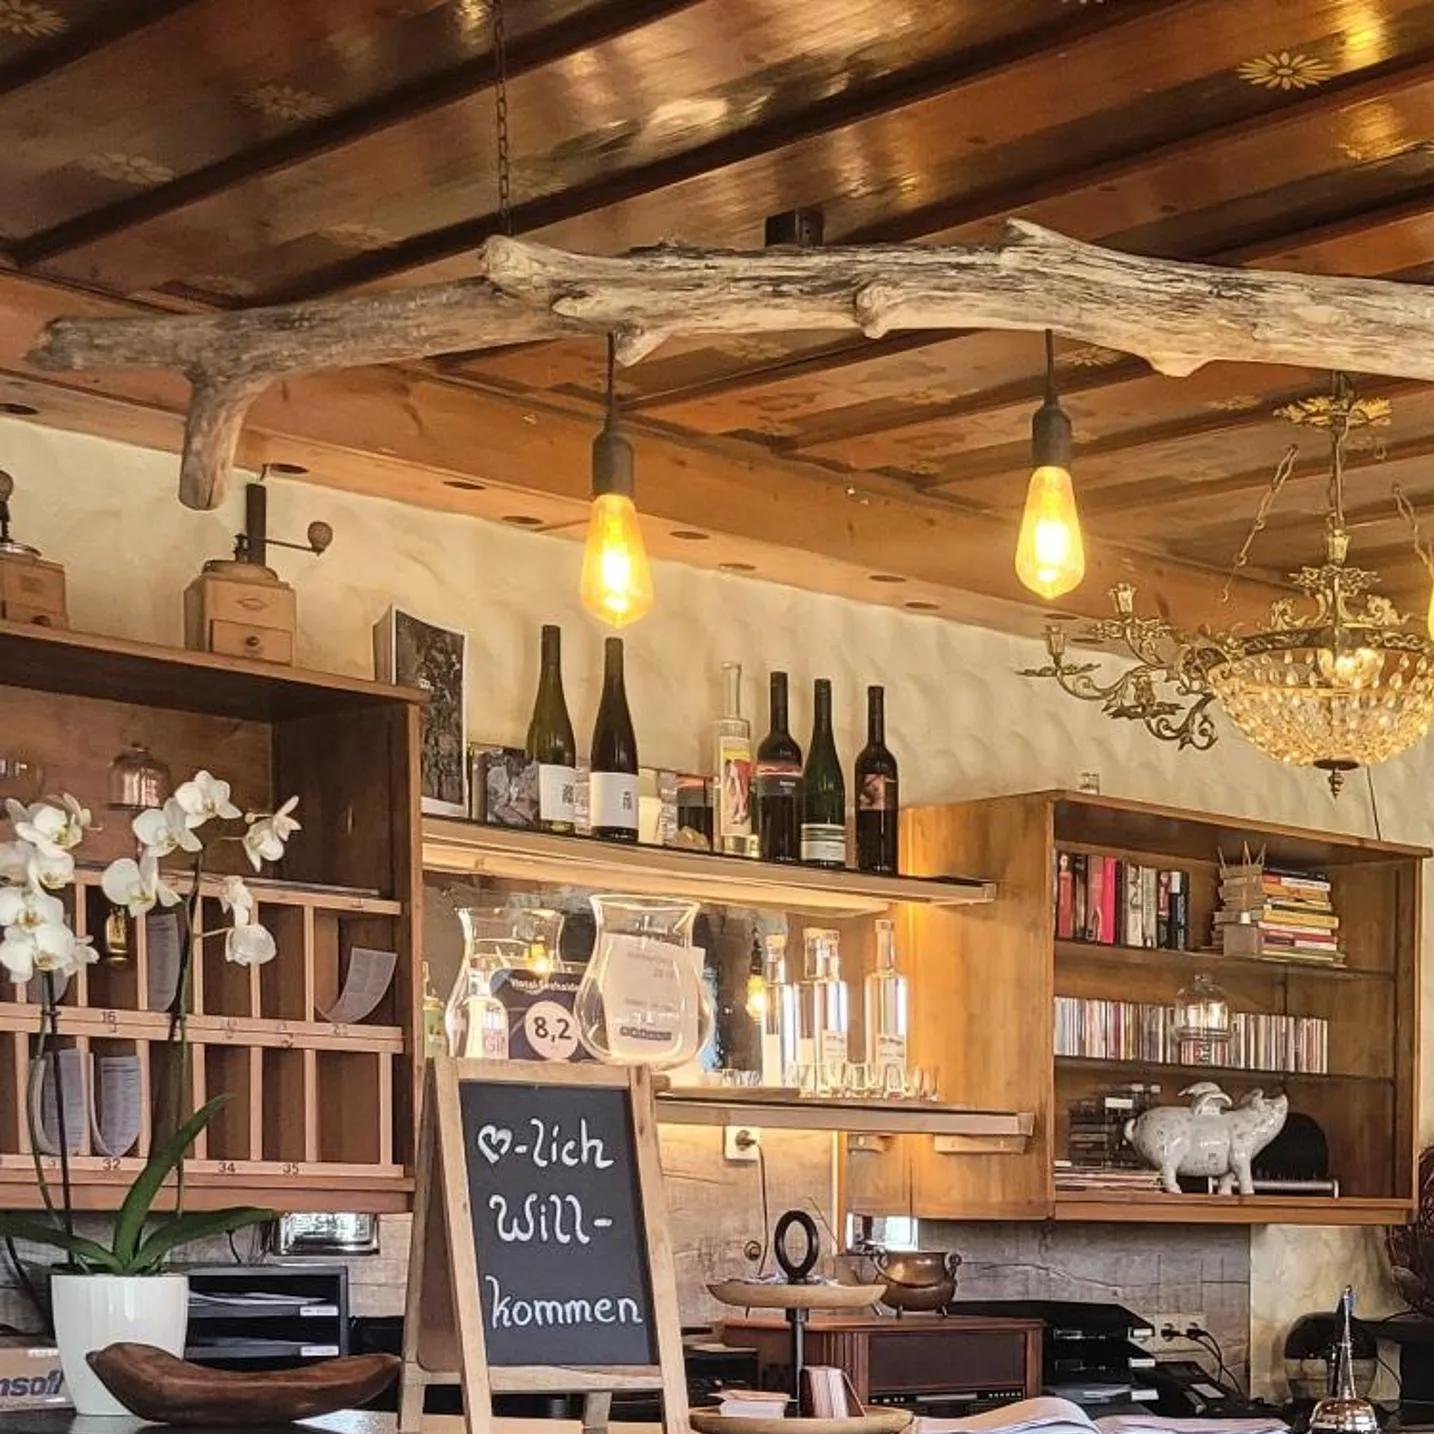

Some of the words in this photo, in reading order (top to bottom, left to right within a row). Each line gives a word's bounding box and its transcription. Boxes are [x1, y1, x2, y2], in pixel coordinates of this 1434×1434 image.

[533, 1016, 572, 1043] 8,2
[102, 1158, 121, 1170] 32
[488, 1194, 613, 1244] Will-
[485, 1275, 643, 1329] kommen
